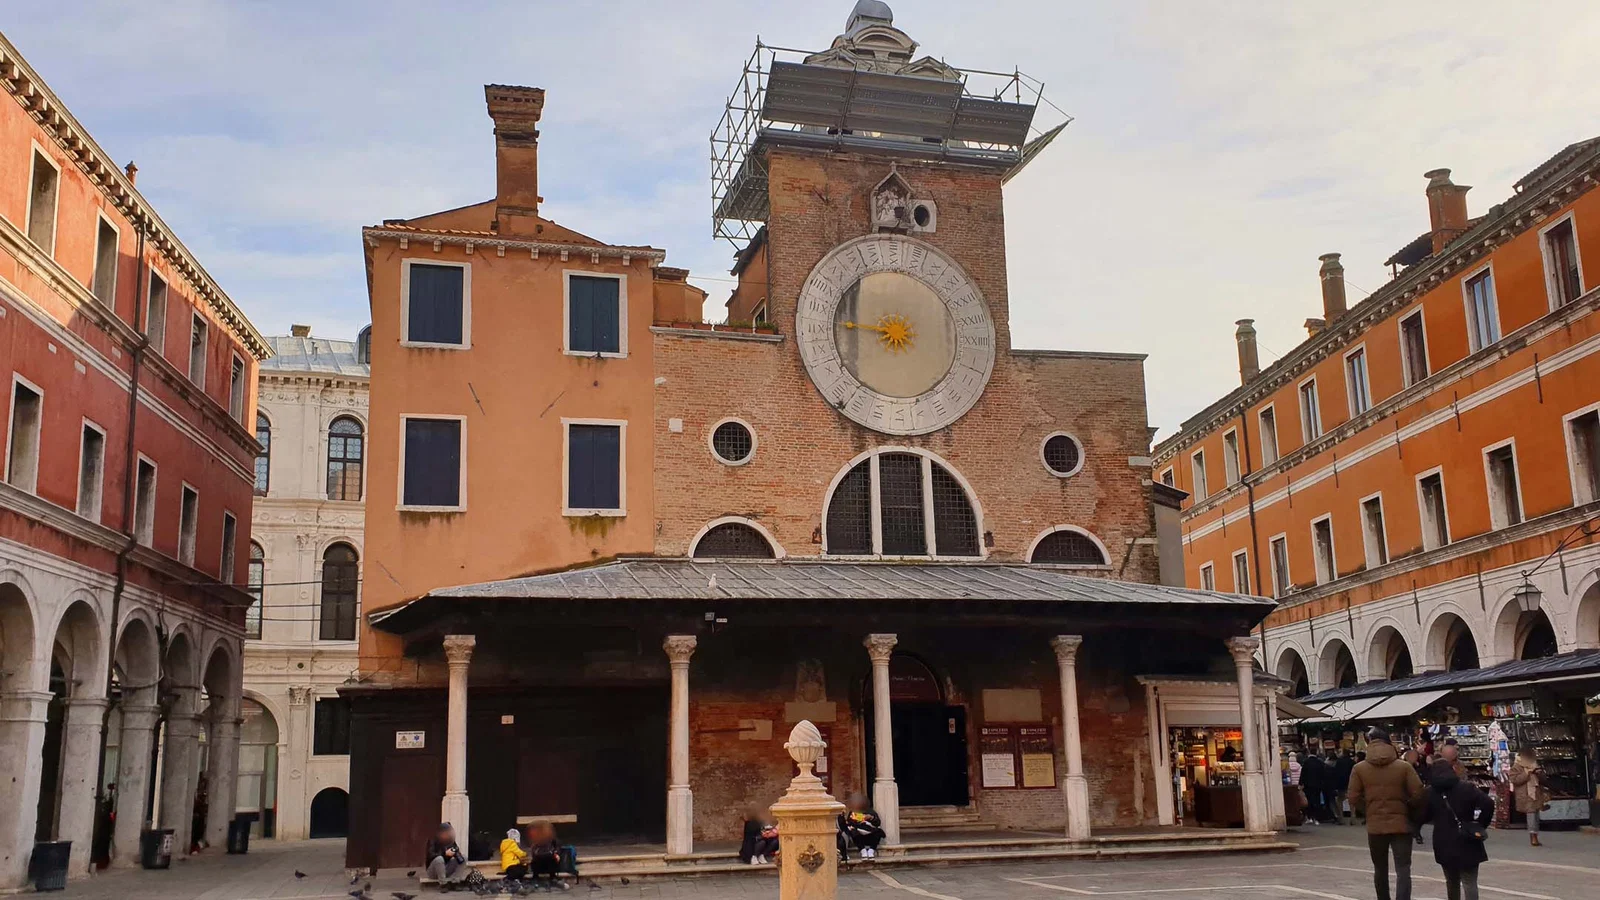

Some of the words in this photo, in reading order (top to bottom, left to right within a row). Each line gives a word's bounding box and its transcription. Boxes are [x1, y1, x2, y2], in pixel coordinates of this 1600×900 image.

[867, 244, 879, 265] XVII
[926, 263, 940, 279] XX
[942, 275, 959, 292] XXI
[953, 292, 976, 307] XXII
[961, 314, 985, 326] XXIII
[808, 324, 825, 333] XII
[964, 336, 988, 345] XXIIII
[812, 344, 826, 355] XI
[825, 365, 834, 375] X
[851, 395, 866, 413] VIII
[873, 405, 884, 419] VII
